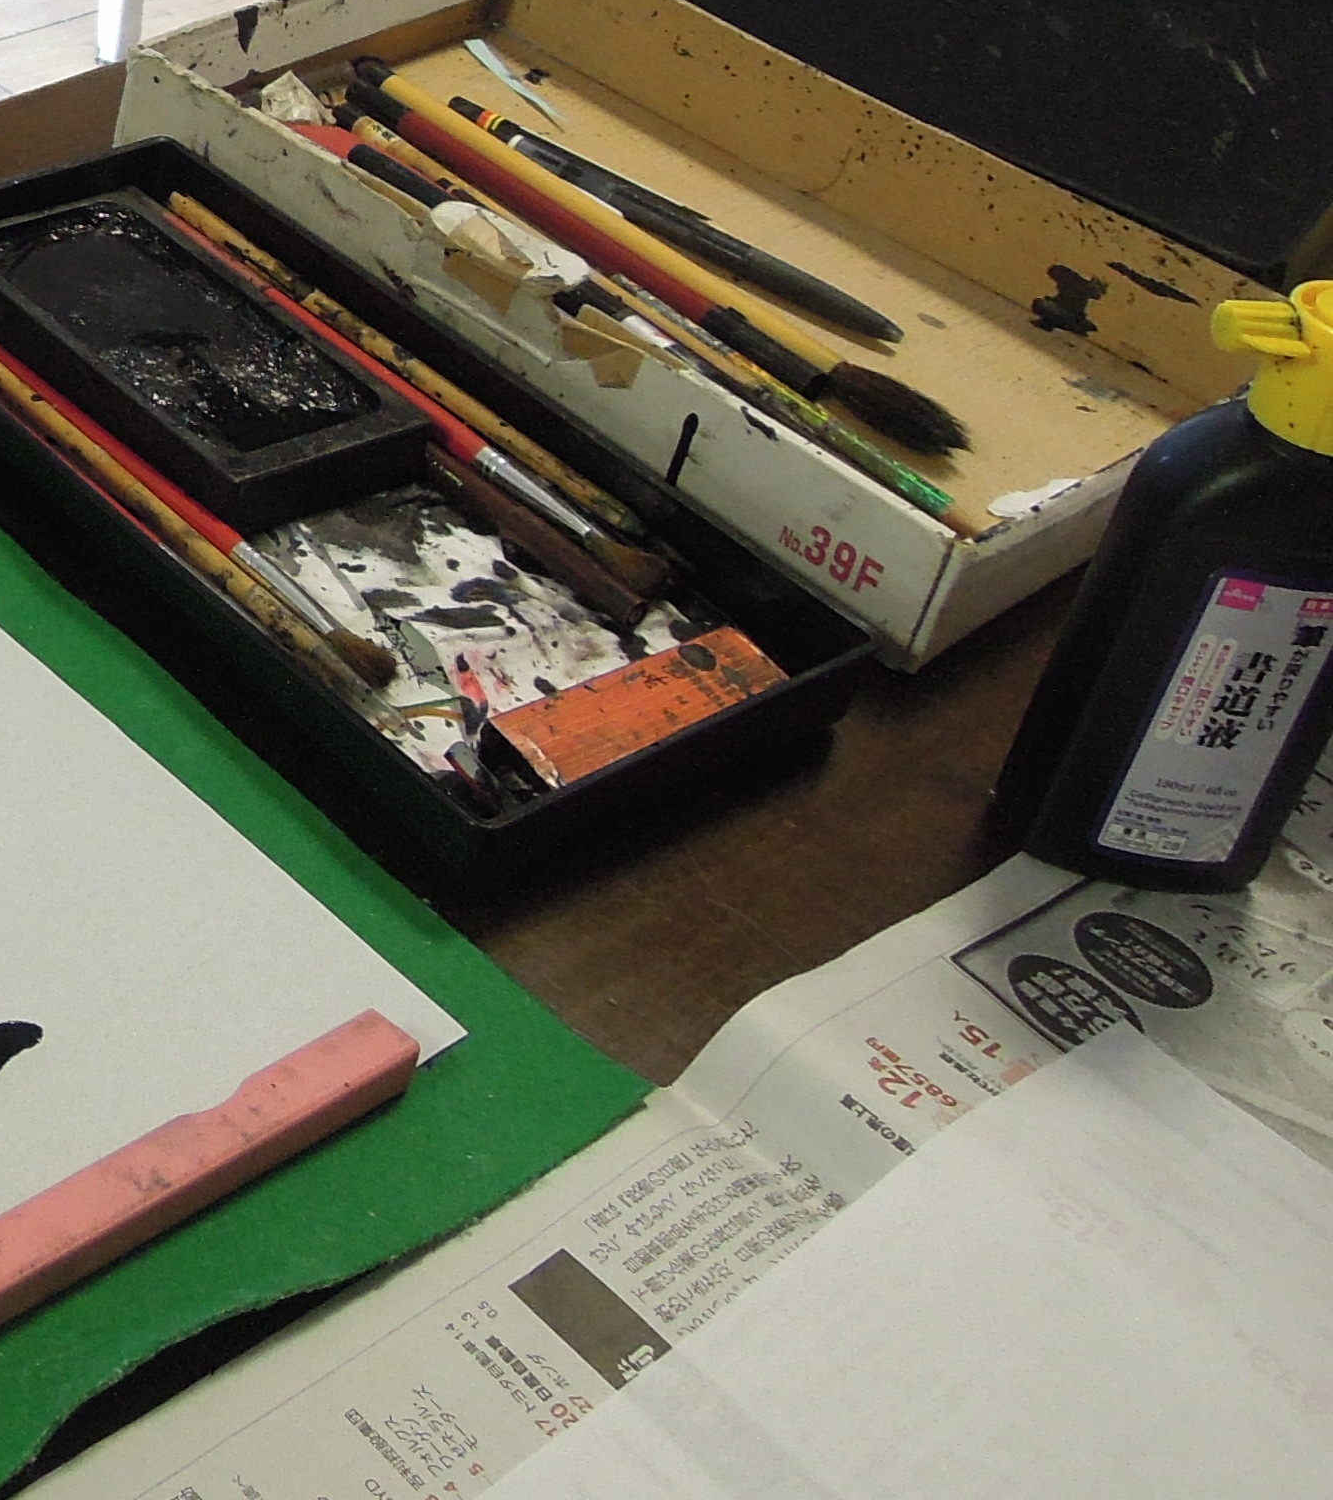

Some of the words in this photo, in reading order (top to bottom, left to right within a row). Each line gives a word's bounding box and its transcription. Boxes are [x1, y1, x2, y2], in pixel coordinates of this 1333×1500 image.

[1196, 651, 1279, 750] 書道液
[954, 1010, 1002, 1059] 15人
[461, 1340, 536, 1413] トヨタ自動車
[484, 1334, 553, 1402] 日産自動車
[526, 1353, 570, 1389] ホンダ
[413, 1385, 478, 1450] モーターズ
[534, 1418, 558, 1437] 17
[550, 1403, 580, 1429] 20
[568, 1395, 594, 1414] 27
[384, 1415, 443, 1477] フォルクス
[402, 1418, 454, 1468] ワーゲン
